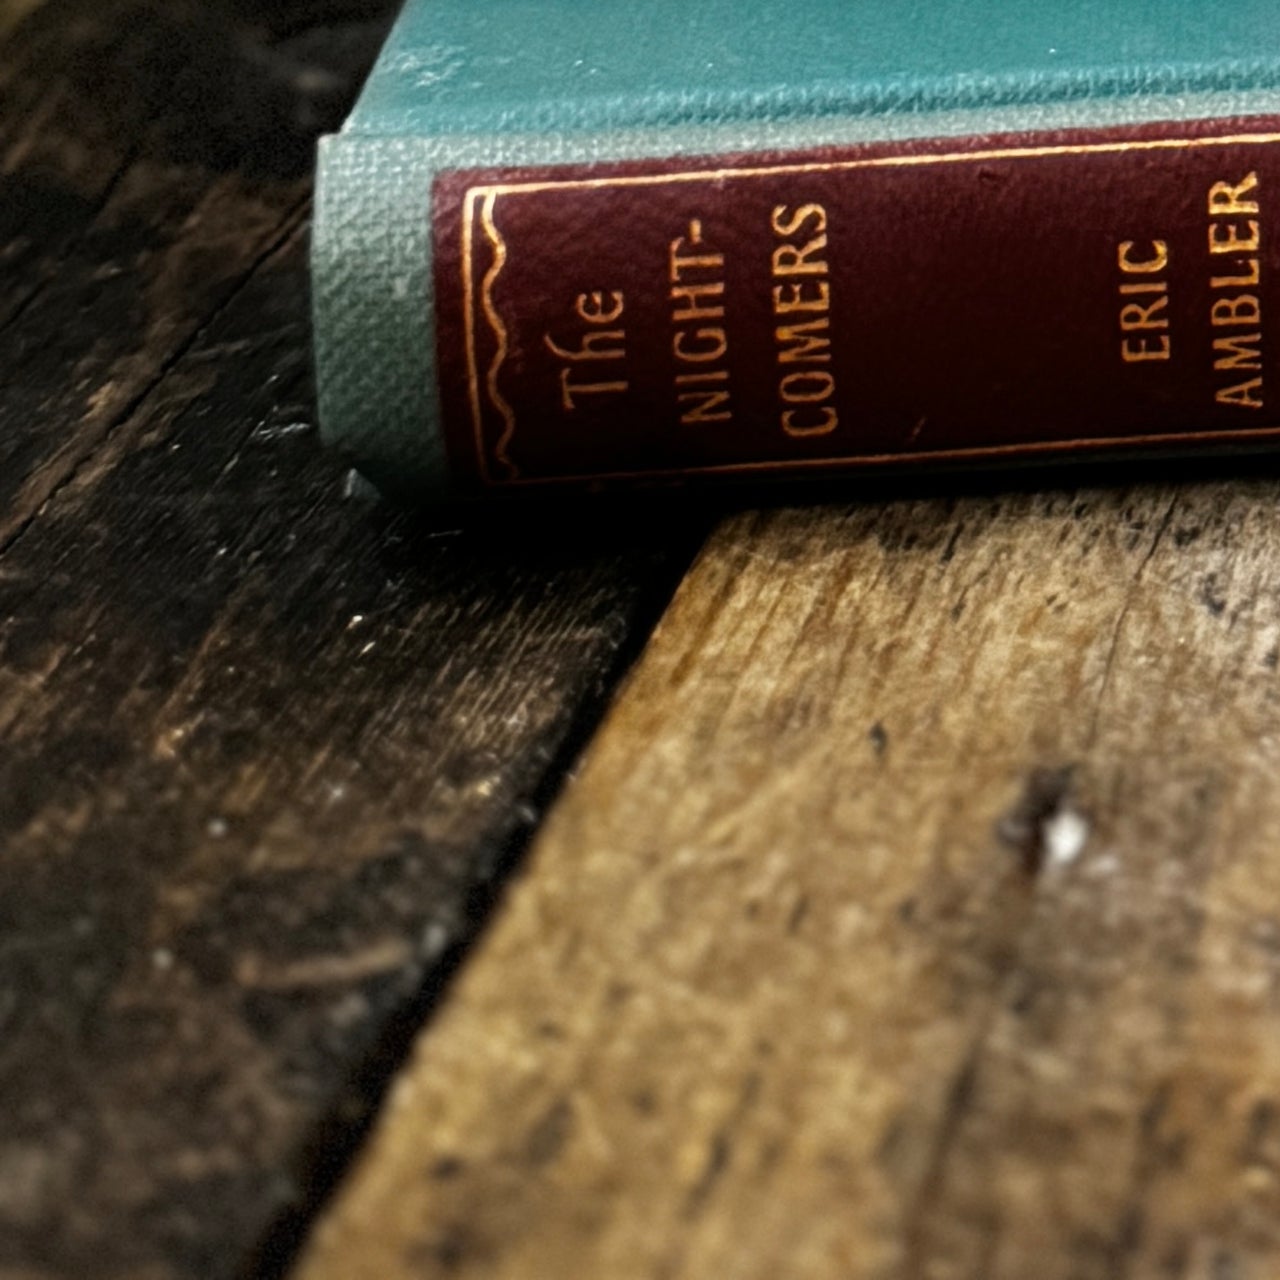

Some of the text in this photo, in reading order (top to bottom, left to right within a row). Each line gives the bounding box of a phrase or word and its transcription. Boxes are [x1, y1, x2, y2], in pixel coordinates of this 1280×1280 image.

[544, 290, 628, 410] The
[668, 218, 733, 425] NIGHT-
[770, 202, 840, 438] COMERS
[1118, 239, 1170, 364] ERIC
[1208, 170, 1264, 410] AMBLER
